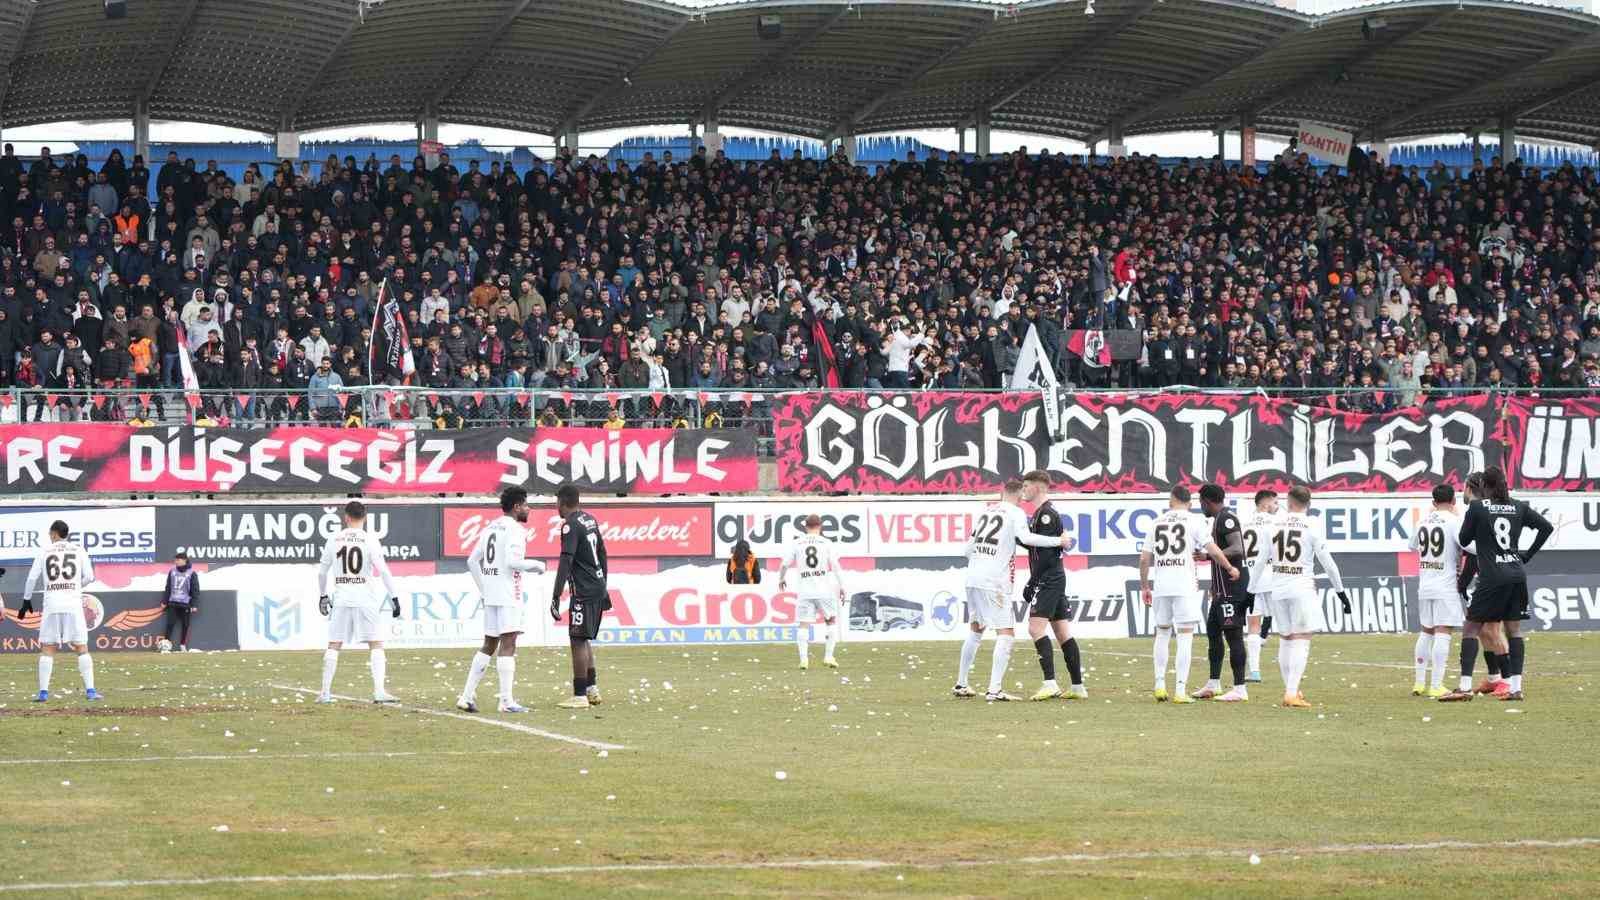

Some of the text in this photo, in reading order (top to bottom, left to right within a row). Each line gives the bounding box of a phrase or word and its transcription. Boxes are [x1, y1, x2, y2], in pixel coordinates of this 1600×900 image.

[1300, 131, 1348, 155] KANTİN
[806, 395, 1484, 483] GÖLKENTLİLER
[0, 427, 730, 490] RE DÜŞECEĞİZ SENİNLE
[208, 506, 389, 541] HANOĞU
[974, 514, 1004, 545] 22
[1494, 517, 1511, 550] 8
[381, 546, 421, 560] ARÇA
[486, 532, 497, 564] 6
[1155, 523, 1186, 556] 53
[1272, 529, 1302, 562] 15
[1418, 526, 1445, 557] 99
[46, 554, 77, 582] 65
[336, 545, 363, 575] 10
[805, 545, 819, 569] 8
[571, 611, 584, 625] 19
[1220, 603, 1235, 618] 13
[599, 627, 806, 642] OPTAN MARKE
